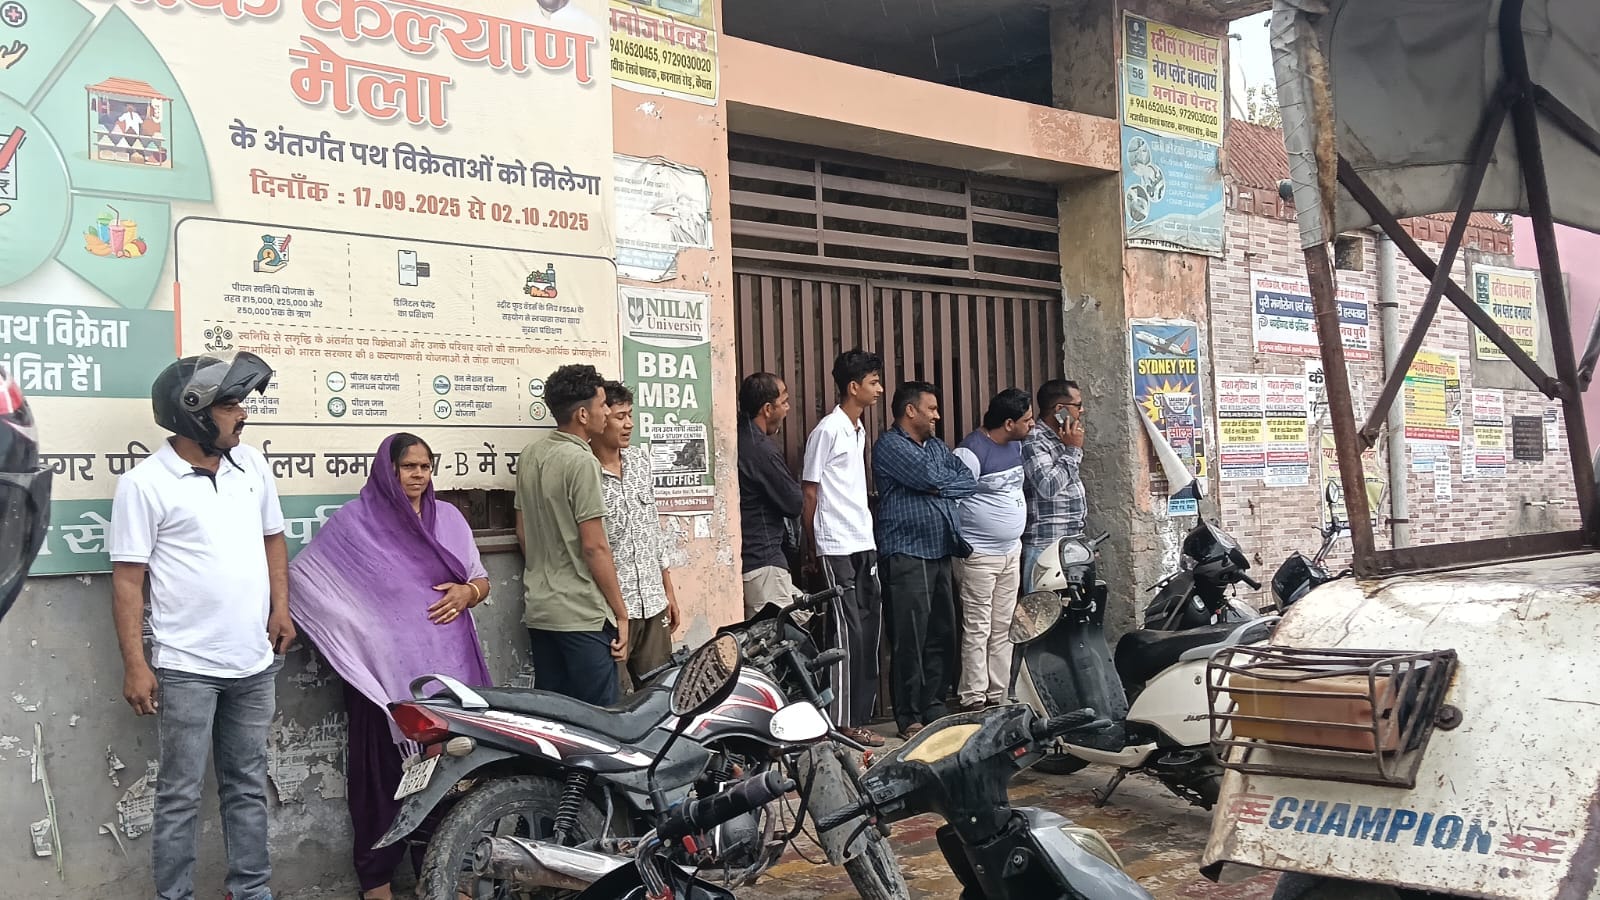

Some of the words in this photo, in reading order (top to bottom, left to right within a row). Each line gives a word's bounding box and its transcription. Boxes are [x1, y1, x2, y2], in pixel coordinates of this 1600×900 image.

[300, 0, 595, 84] कल्याण
[662, 15, 708, 52] पेन्टर
[609, 37, 661, 64] 9416520455,
[662, 50, 711, 73] 9729030020
[1187, 40, 1218, 65] मार्बल
[288, 34, 452, 127] मेला
[695, 75, 712, 91] कैथल
[1132, 66, 1144, 80] 58
[1152, 54, 1167, 80] नेम
[1169, 59, 1186, 85] प्लेट
[1152, 84, 1188, 106] मनोज
[1190, 90, 1218, 113] पेन्टर
[229, 118, 257, 150] के
[264, 125, 345, 162] अंतर्गत
[350, 142, 389, 169] पथ
[393, 141, 494, 182] विक्रेताओं
[497, 159, 527, 187] को
[530, 160, 601, 196] मिलेगा
[353, 186, 461, 217] 17.09.2025
[467, 195, 487, 221] से
[491, 202, 590, 232] 02.10.2025
[1258, 293, 1270, 313] पुरी
[47, 309, 130, 348] विक्रेता
[647, 317, 703, 336] University
[68, 354, 101, 391] हैं।
[637, 351, 698, 380] BBA
[1138, 358, 1177, 376] SYDNEY
[1178, 359, 1196, 375] PTE
[638, 382, 699, 409] MBA
[476, 441, 498, 476] में
[666, 474, 701, 486] OFFICE
[1268, 796, 1493, 855] CHAMPION
